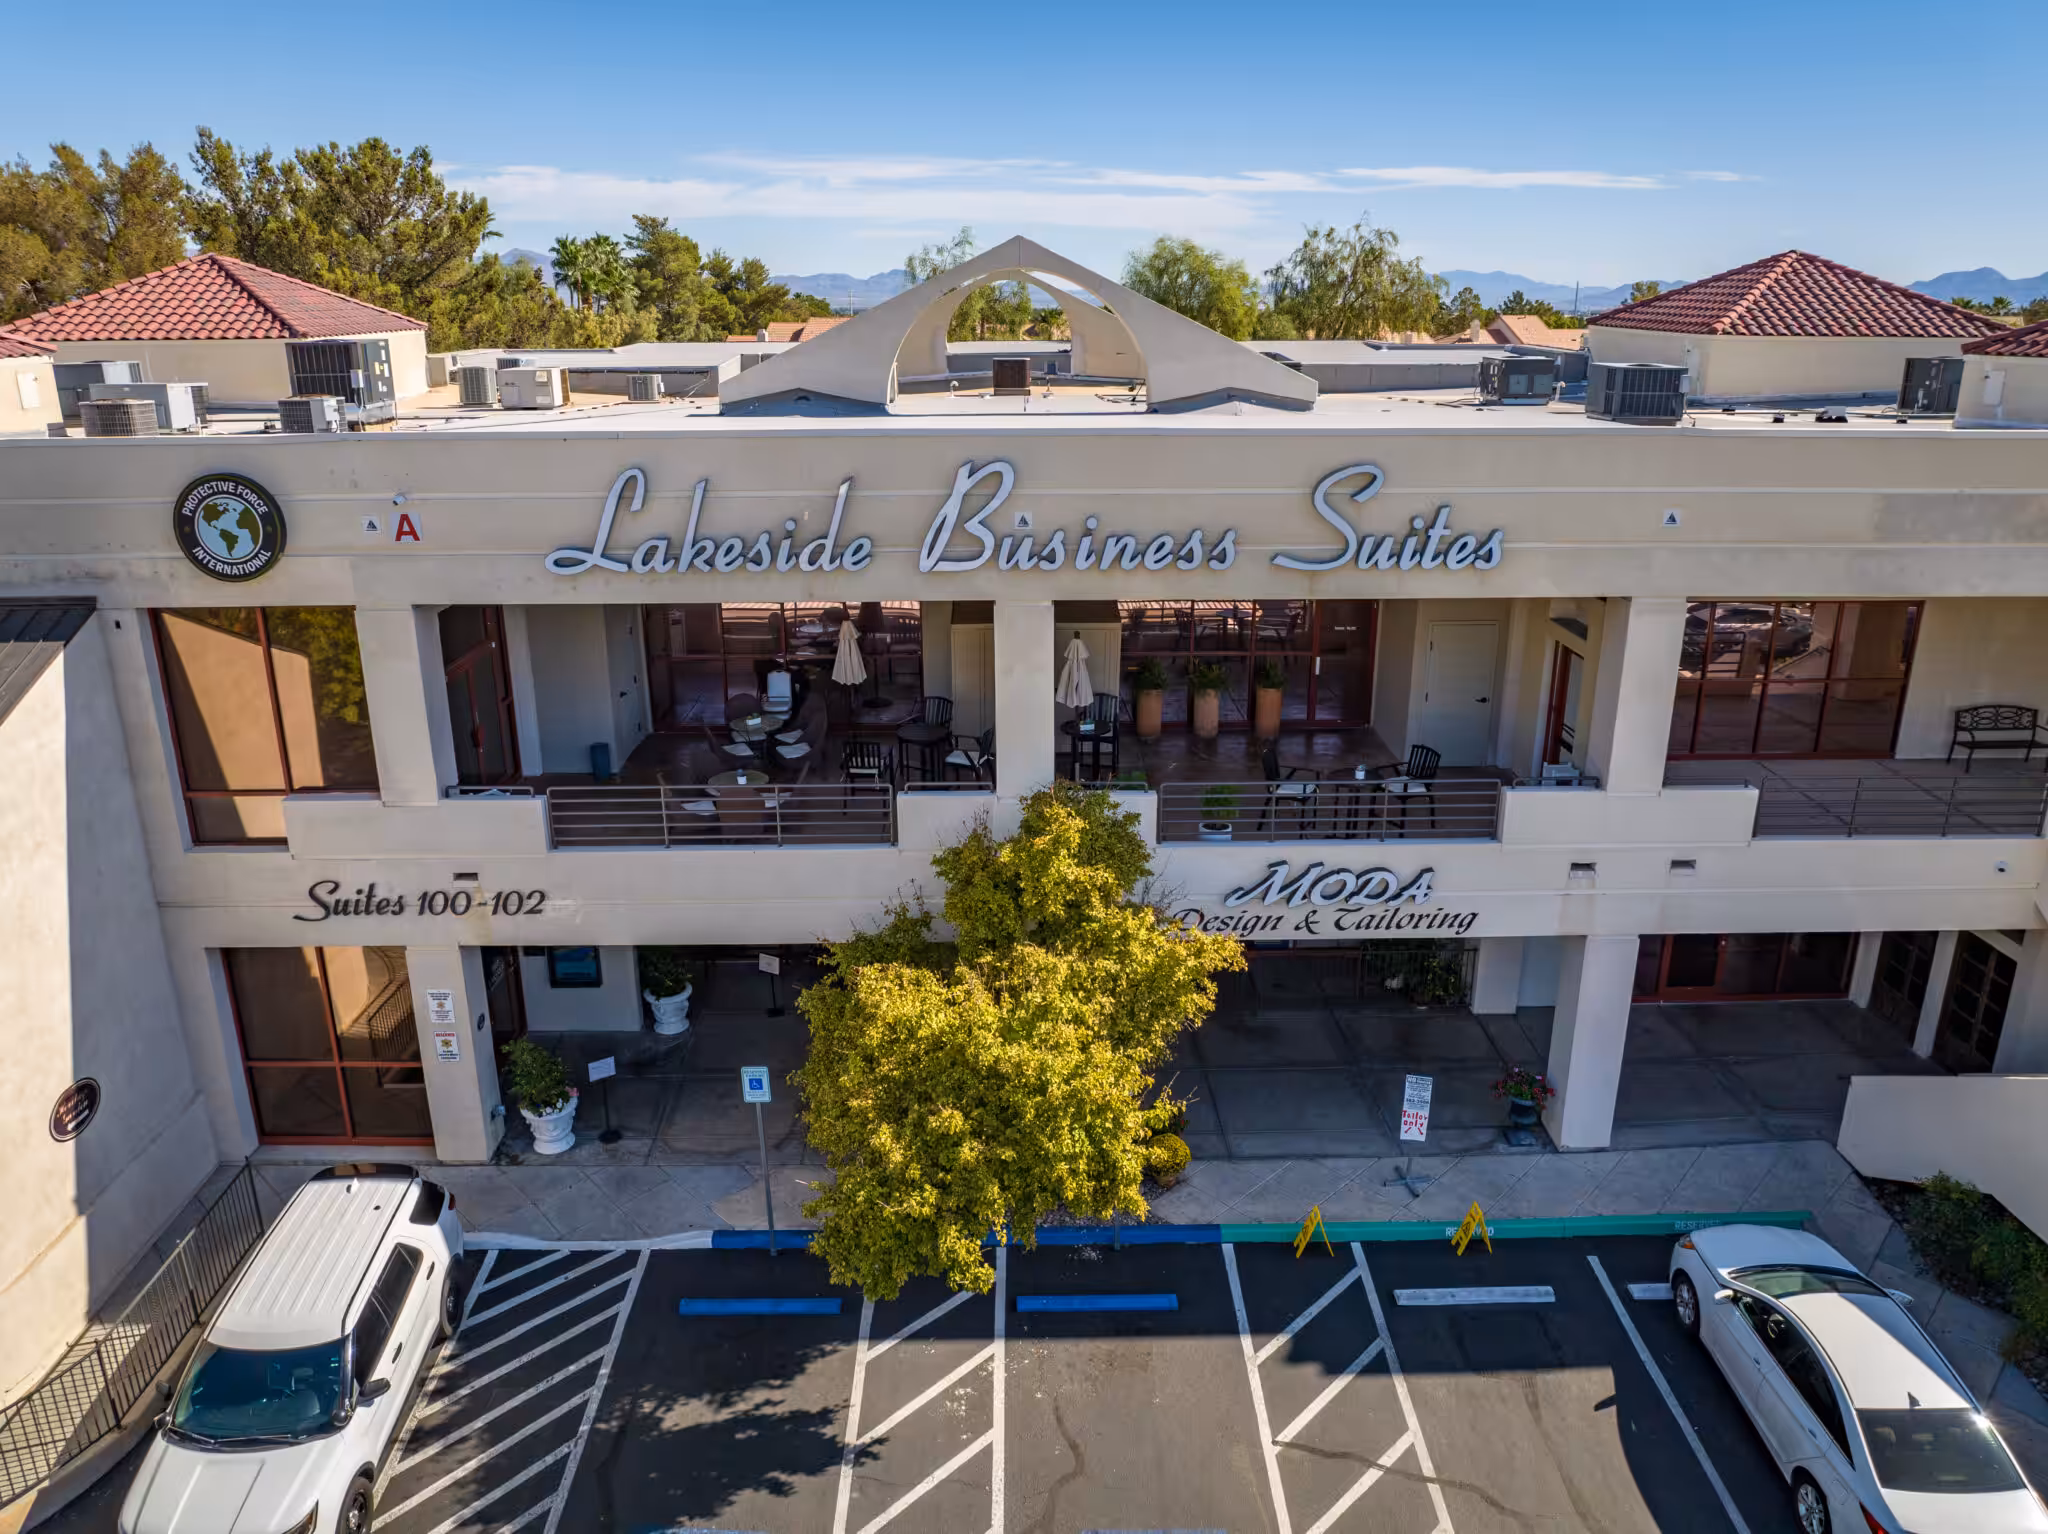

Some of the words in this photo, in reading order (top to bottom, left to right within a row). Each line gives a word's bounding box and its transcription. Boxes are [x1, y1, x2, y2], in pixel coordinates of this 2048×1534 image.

[182, 481, 236, 516] PROTECTIVE
[236, 485, 268, 515] FORCE
[395, 513, 420, 541] A
[545, 467, 873, 575] Lakeside
[918, 460, 1237, 573] Business
[1271, 463, 1504, 571] Suites
[192, 547, 272, 576] INTERNATIONAL
[294, 880, 405, 922] Suites
[417, 889, 547, 916] 100-102
[1224, 860, 1436, 909] MODA
[1172, 908, 1284, 938] Design
[1295, 909, 1321, 935] &
[1334, 907, 1479, 935] Tailoring
